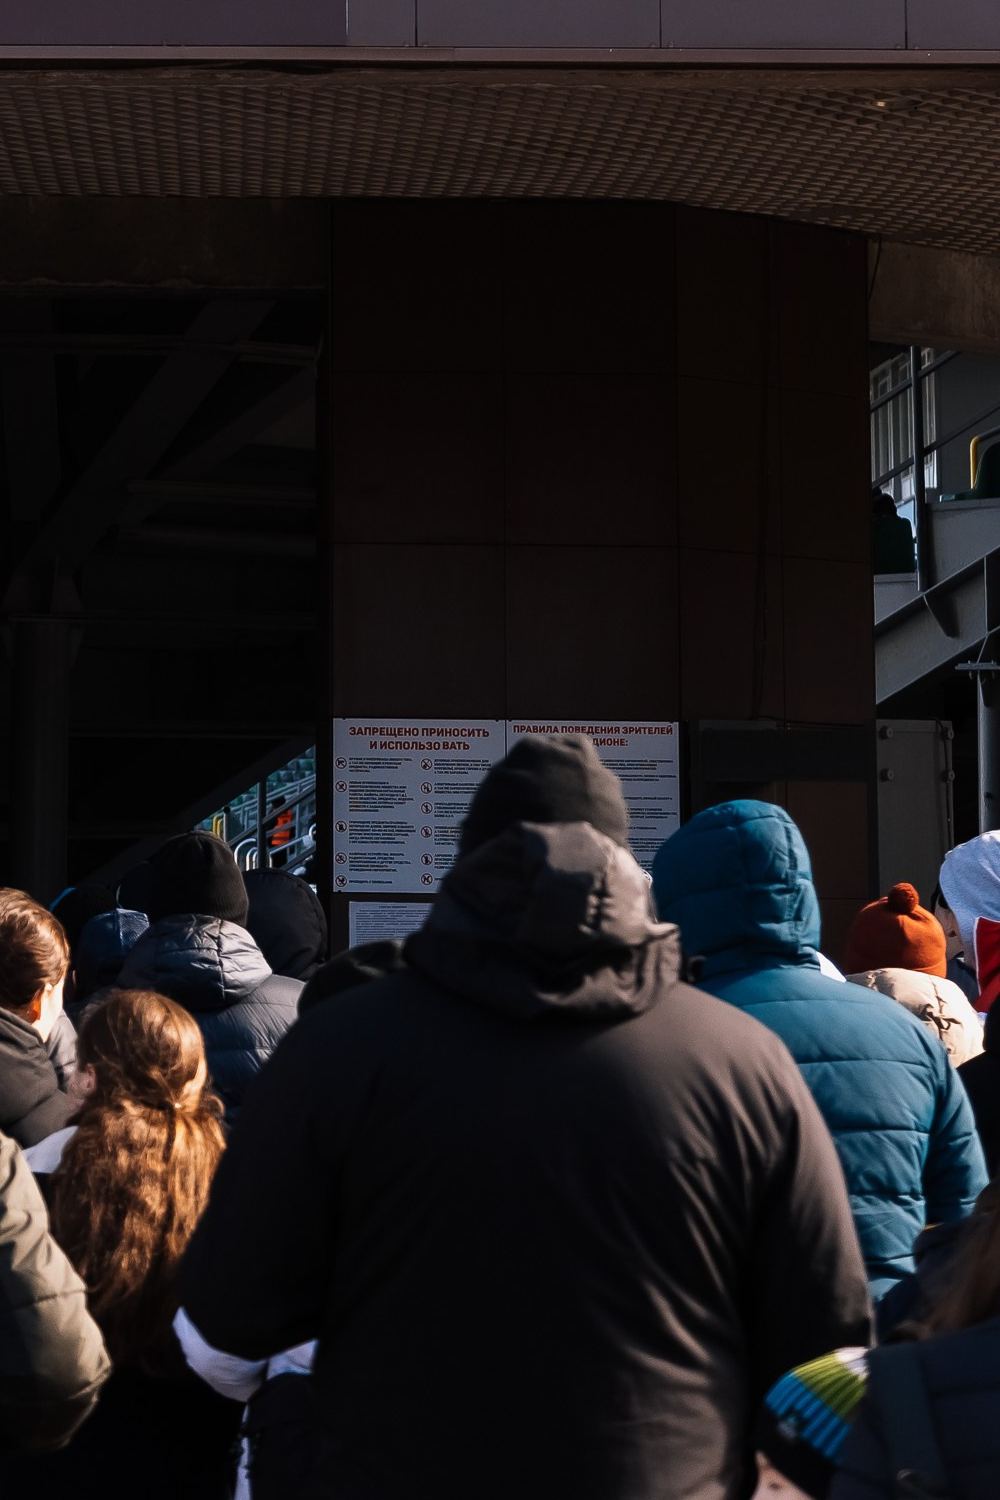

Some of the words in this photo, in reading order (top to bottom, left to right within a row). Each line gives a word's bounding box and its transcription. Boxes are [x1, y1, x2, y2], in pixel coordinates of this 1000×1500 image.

[349, 726, 419, 738] ЗАПРЕЩЕНО
[421, 727, 490, 738] ПРИНОСИТЬ
[513, 725, 559, 734] ПРАВИЛА
[561, 725, 621, 735] ПОВЕДЕНИЯ
[622, 725, 673, 735] ЗРИТЕЛЕЙ
[369, 741, 377, 750] И
